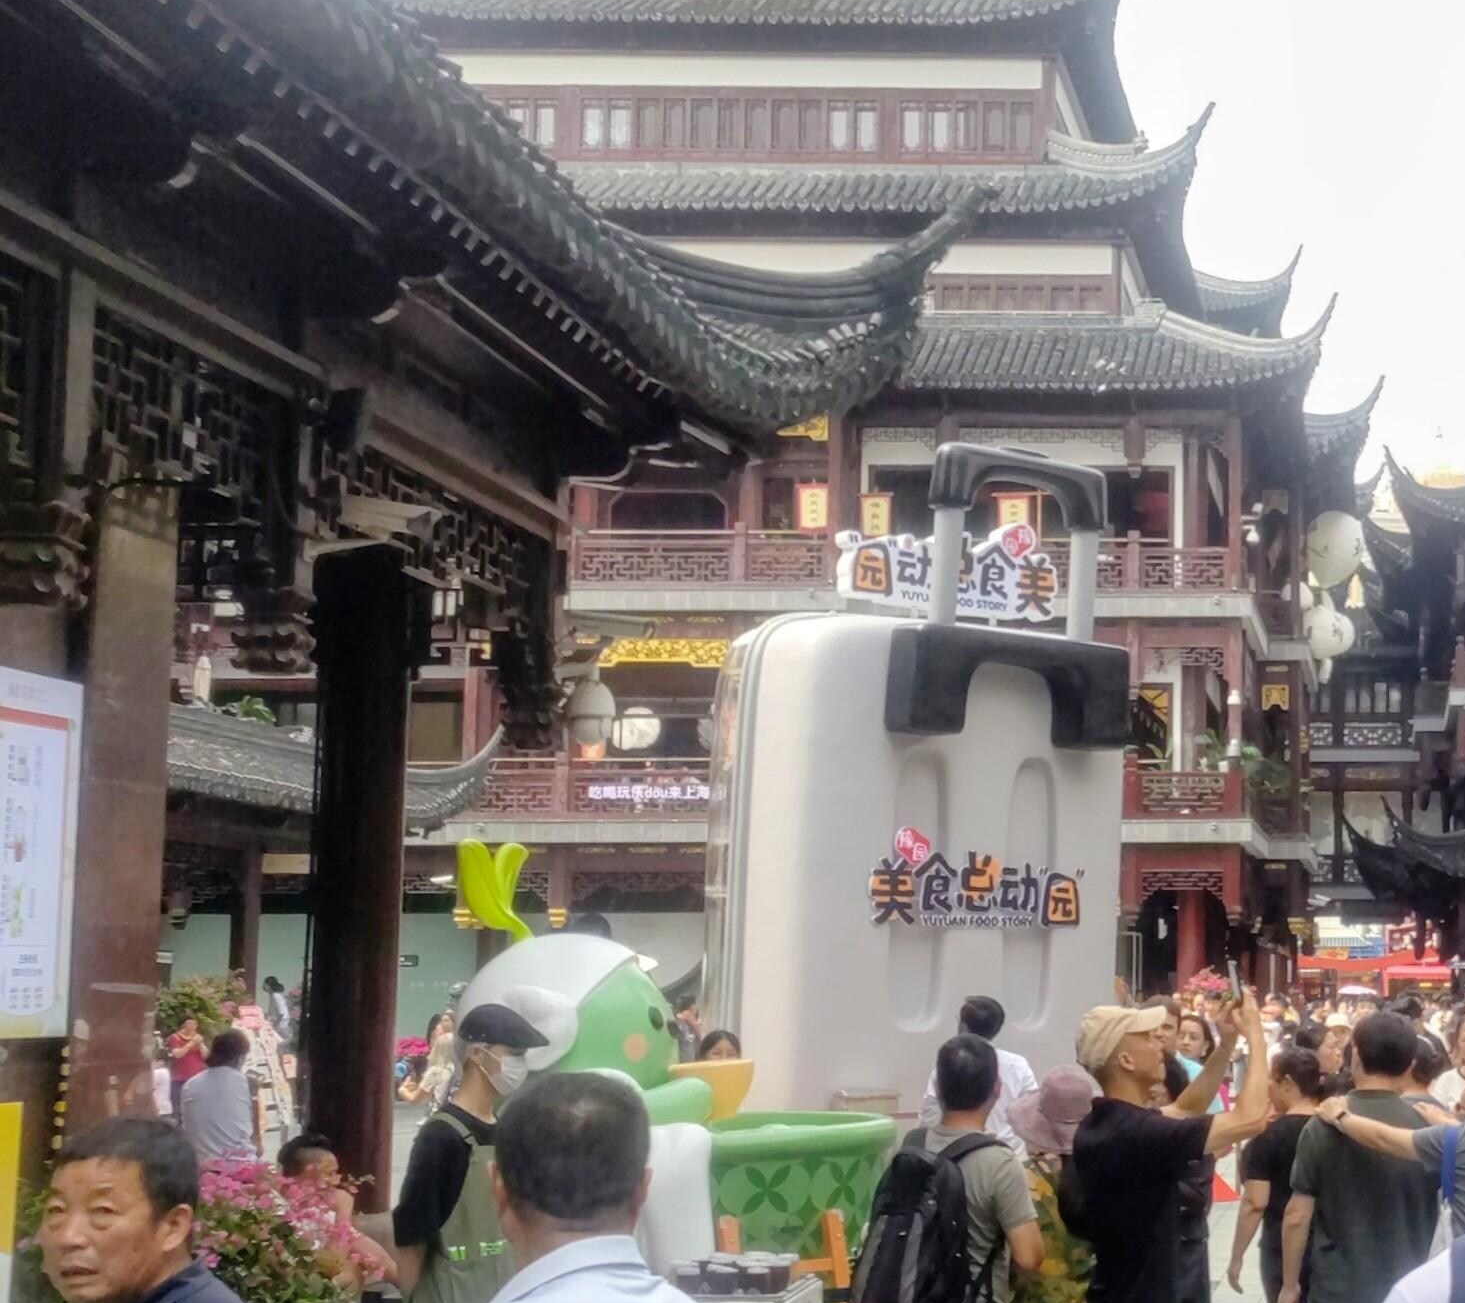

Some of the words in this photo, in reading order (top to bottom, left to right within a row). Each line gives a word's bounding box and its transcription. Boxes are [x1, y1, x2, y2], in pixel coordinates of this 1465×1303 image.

[976, 599, 1008, 611] STORY
[921, 915, 966, 927] YUYUAN
[969, 915, 998, 927] FOOD
[1001, 915, 1033, 927] STORY
